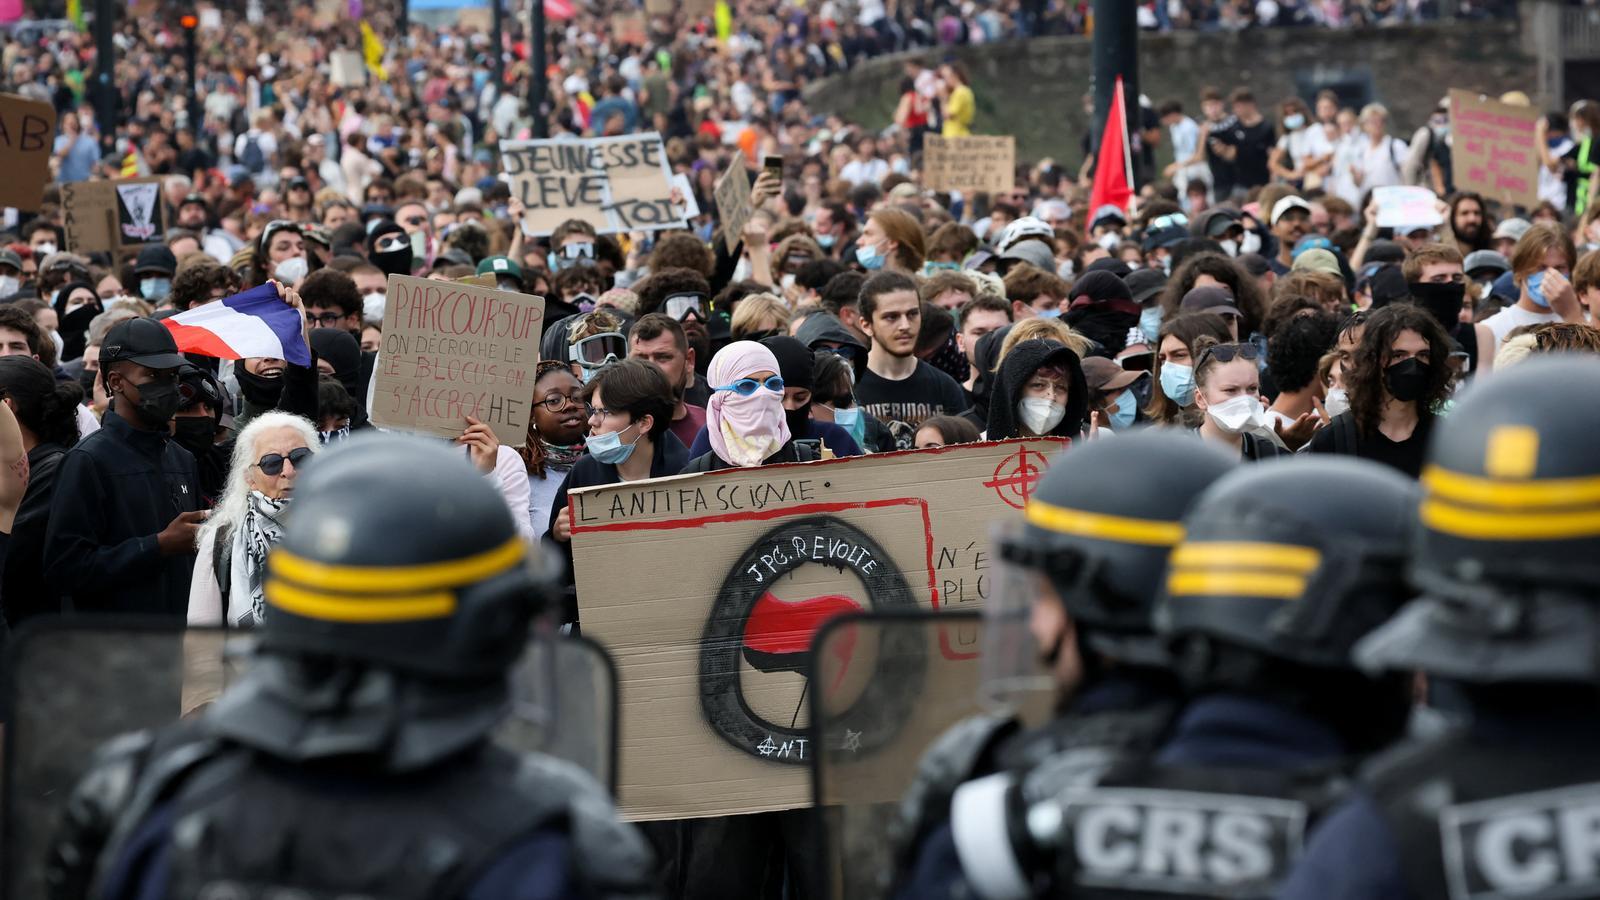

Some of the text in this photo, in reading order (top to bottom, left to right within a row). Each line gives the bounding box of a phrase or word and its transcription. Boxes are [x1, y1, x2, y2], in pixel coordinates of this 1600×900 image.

[502, 139, 662, 175] JEUNESSE
[522, 175, 609, 209] LEVE
[598, 198, 682, 229] TOI
[394, 282, 542, 340] PARCOURSUP
[386, 333, 523, 363] ON DÉCROCHE LE
[383, 354, 526, 386] LE BLOCUS ON
[937, 541, 992, 571] N'E
[943, 574, 991, 606] PLU
[1074, 804, 1275, 885] CRS
[1475, 804, 1600, 897] CR
